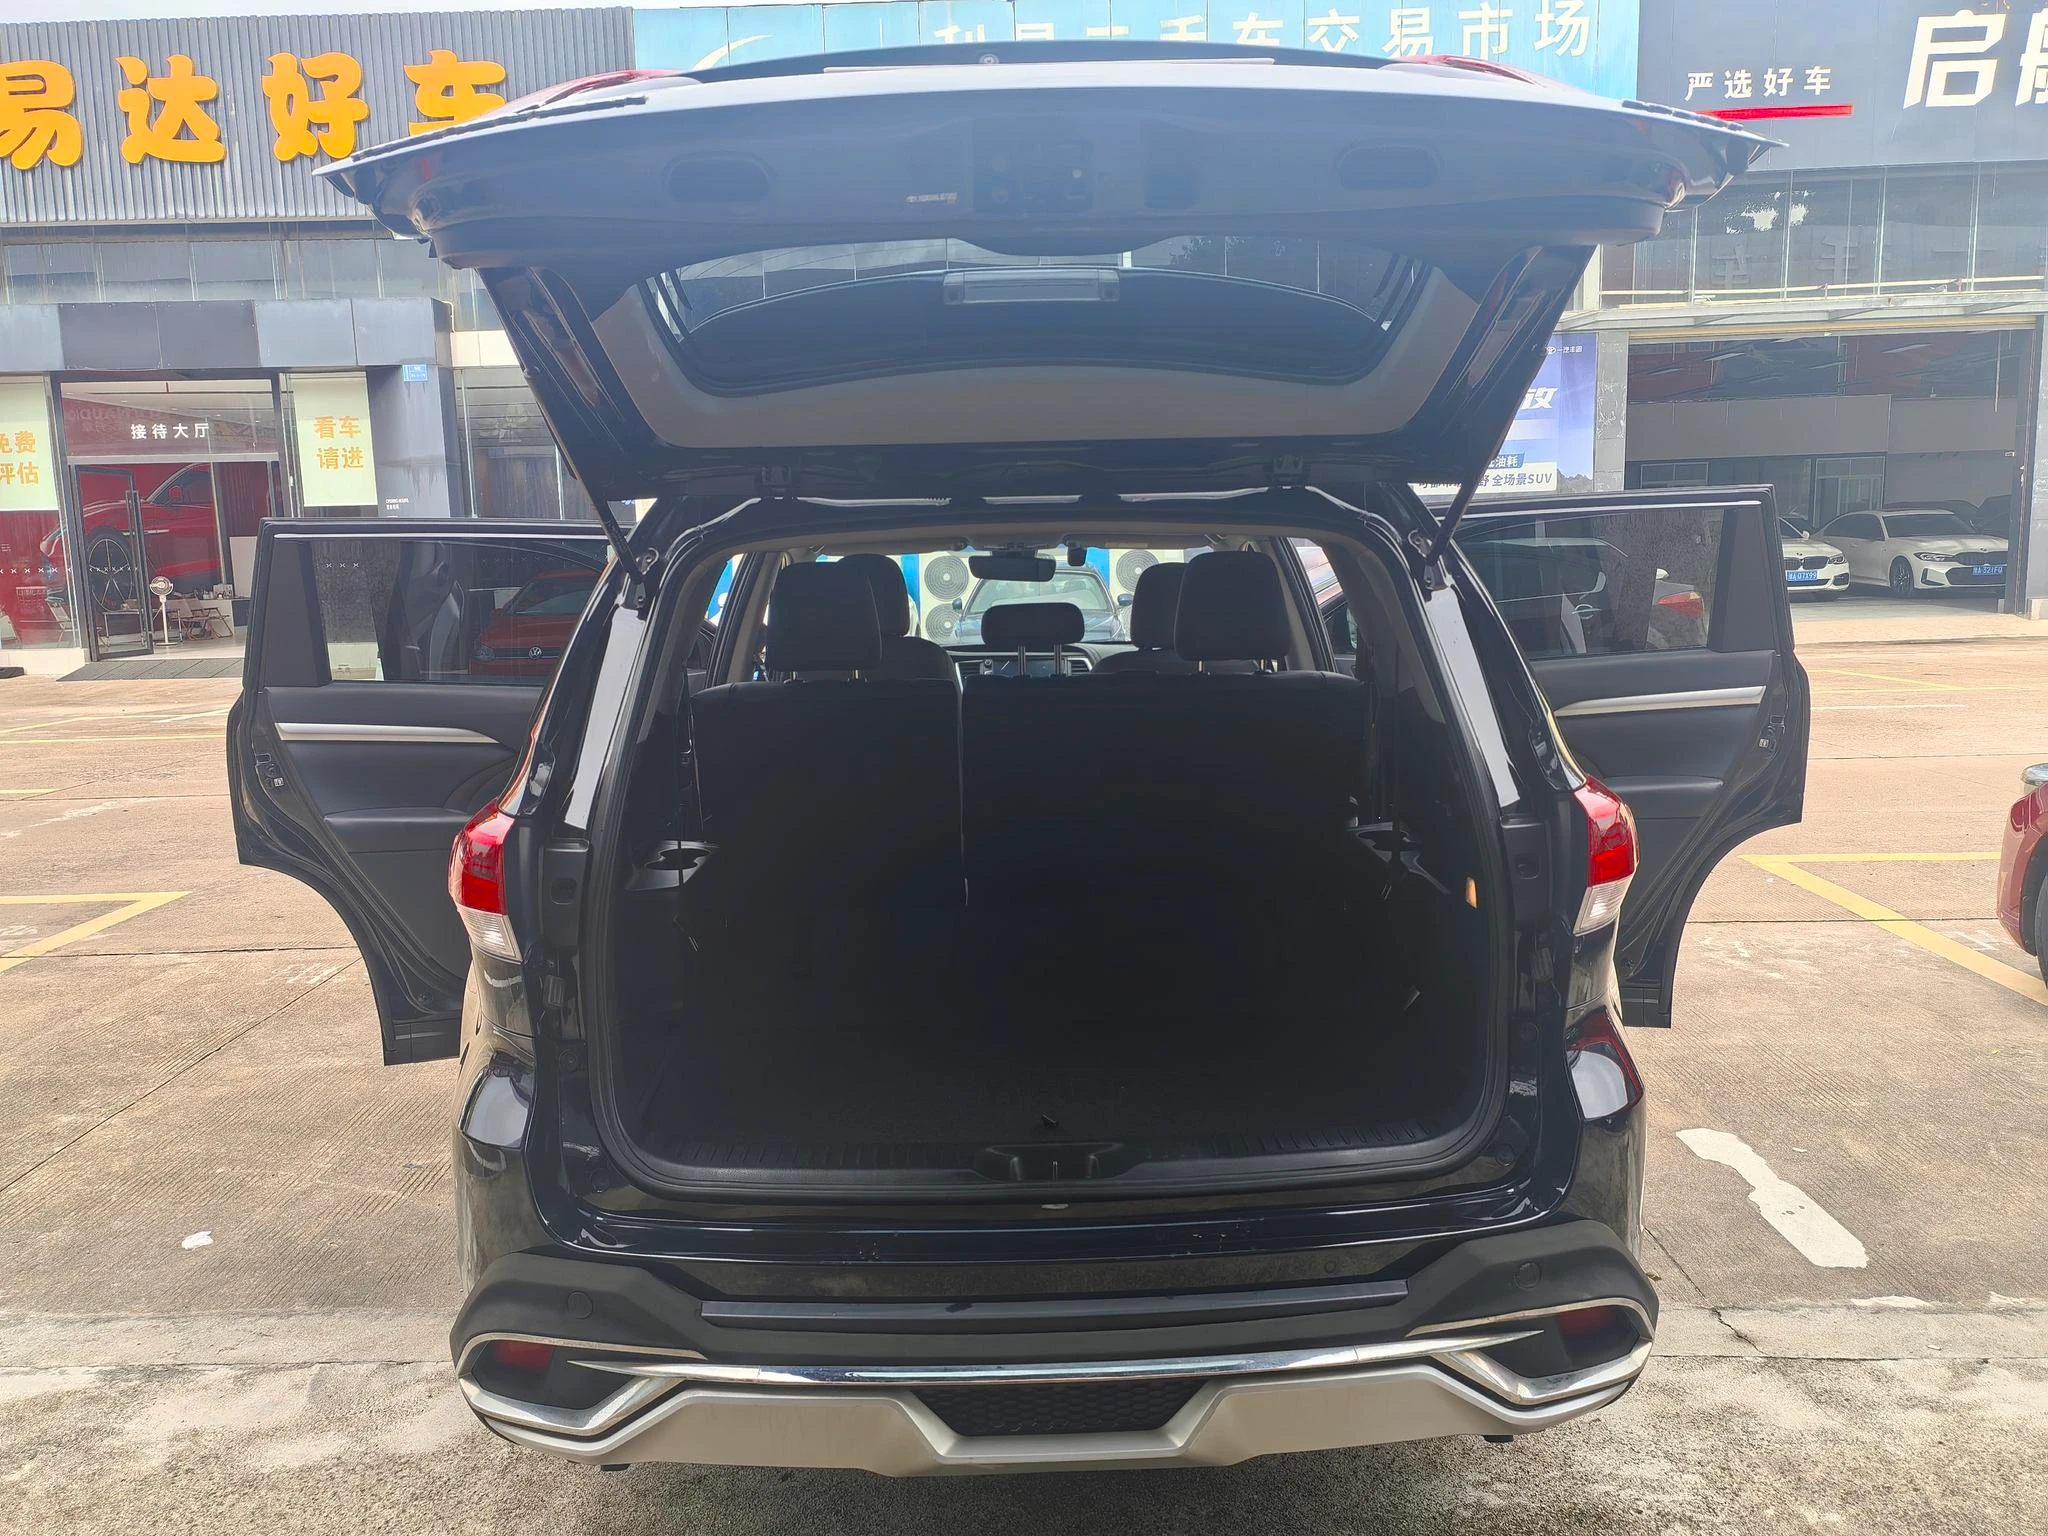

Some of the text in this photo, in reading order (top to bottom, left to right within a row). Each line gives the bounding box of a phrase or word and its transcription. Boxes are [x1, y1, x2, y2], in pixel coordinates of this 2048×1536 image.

[1685, 65, 1831, 101] 严选好车
[130, 422, 209, 440] 接待大厅
[313, 416, 361, 438] 看车
[316, 446, 364, 469] 请进
